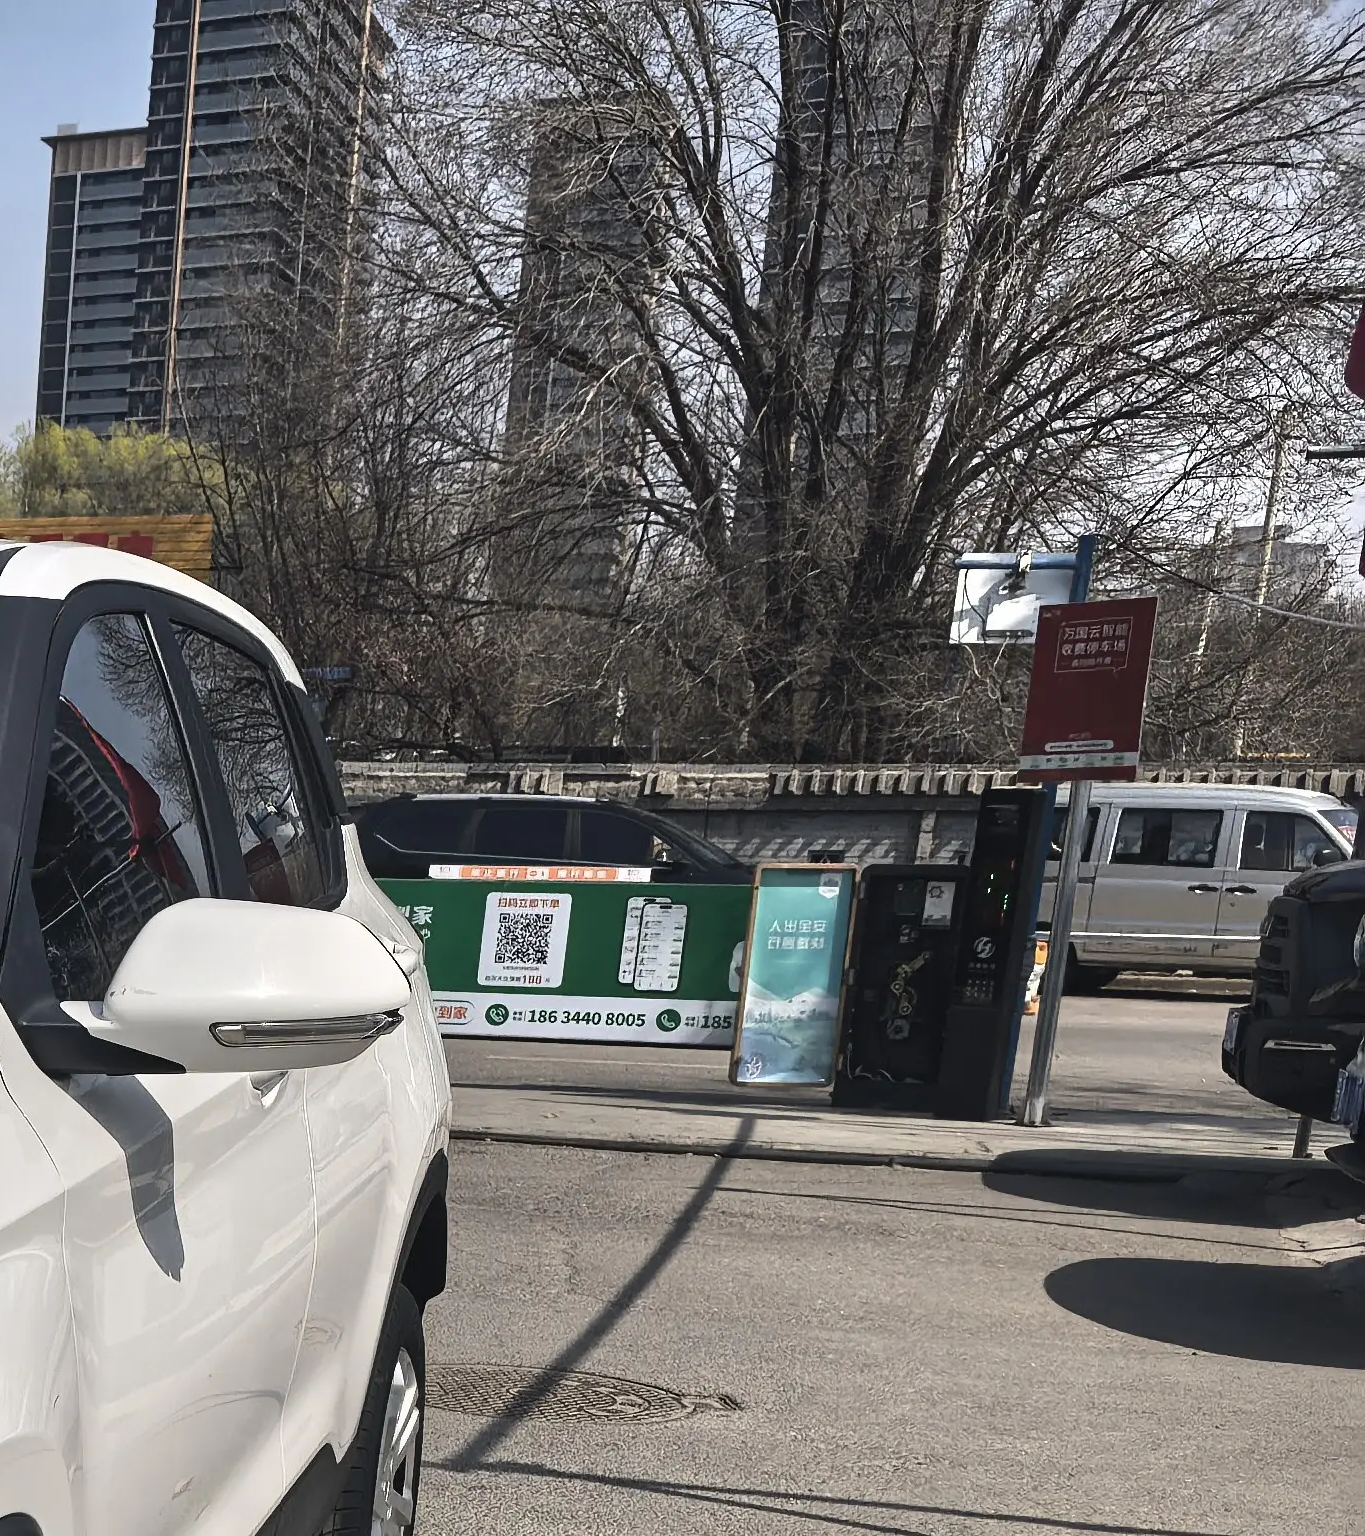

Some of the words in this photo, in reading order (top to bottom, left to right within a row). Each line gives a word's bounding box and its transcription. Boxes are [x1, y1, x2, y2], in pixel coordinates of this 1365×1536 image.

[435, 1005, 468, 1020] 到家
[527, 1008, 558, 1025] 186
[559, 1010, 602, 1026] 3440
[605, 1012, 647, 1028] 8005
[700, 1014, 733, 1030] 185
